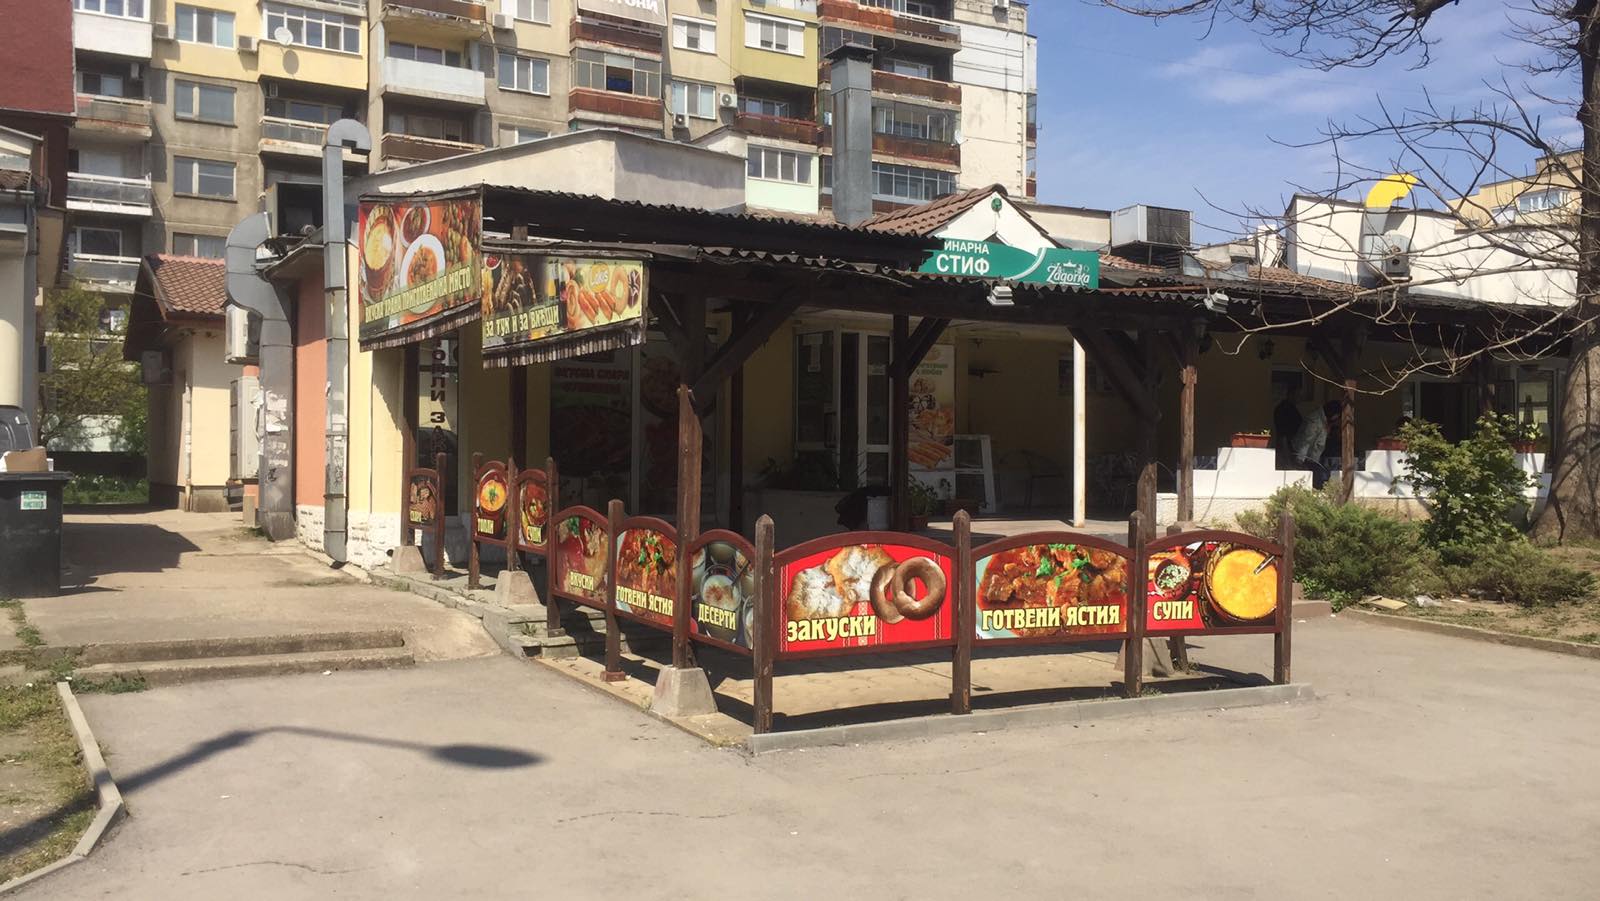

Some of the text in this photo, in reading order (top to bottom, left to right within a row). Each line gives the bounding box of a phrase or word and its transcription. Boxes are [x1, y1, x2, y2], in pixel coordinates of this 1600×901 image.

[943, 240, 989, 255] ИНАРНА
[936, 254, 989, 276] СТИФ
[1046, 262, 1090, 286] Zagorka
[616, 585, 674, 617] ГОТВЕНИ ЯСТИЯ
[1153, 600, 1194, 621] СУПИ
[698, 603, 736, 631] ДЕСЕРТИ
[981, 605, 1120, 631] ГОТВЕНИ ЯСТИЯ
